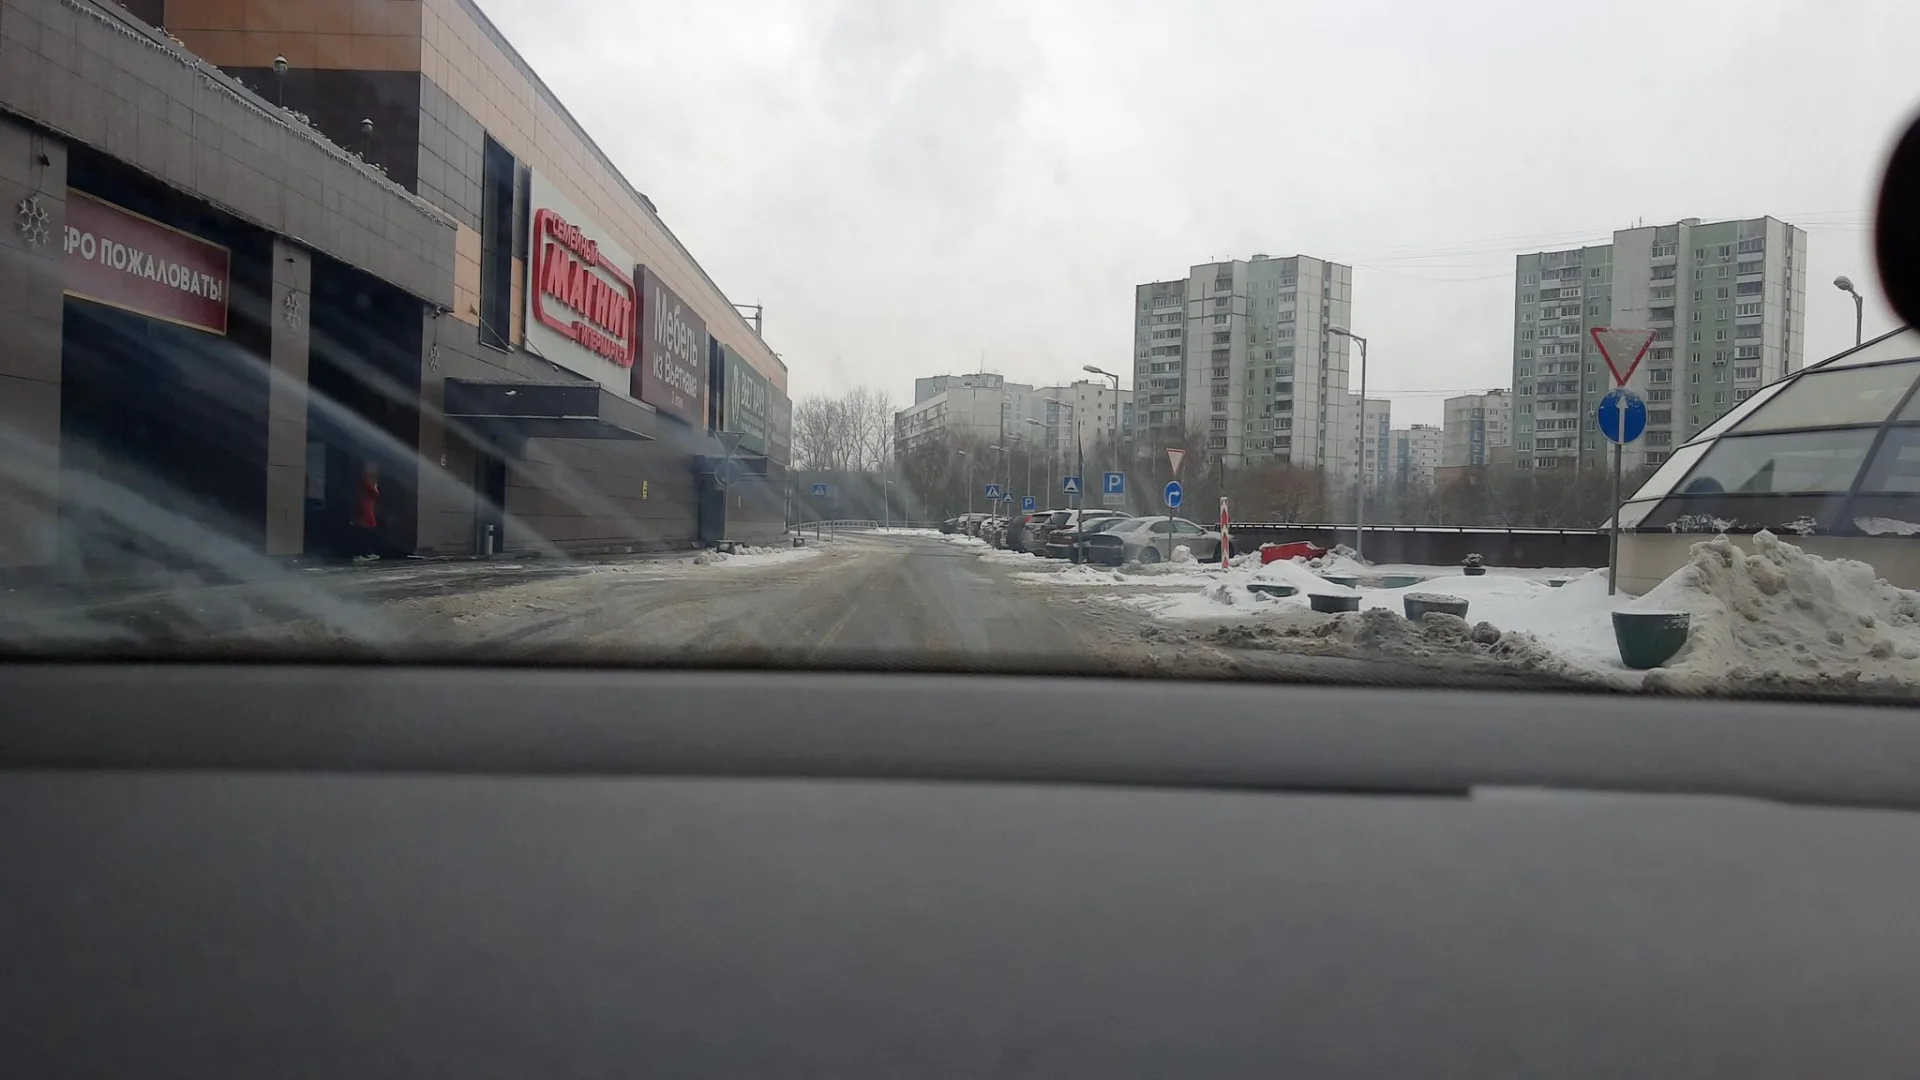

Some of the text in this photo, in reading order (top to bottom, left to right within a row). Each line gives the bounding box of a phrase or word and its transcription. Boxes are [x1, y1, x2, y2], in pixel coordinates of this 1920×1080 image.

[551, 214, 598, 266] СЕМЕЙНЫЙ
[100, 238, 222, 302] ПОЖАЛОВАТЬ!
[543, 244, 631, 340] МАГНИТ
[654, 287, 698, 367] Мебель
[653, 352, 663, 380] из
[664, 351, 697, 399] Вьетнама
[1024, 498, 1032, 508] P
[1109, 475, 1120, 492] P
